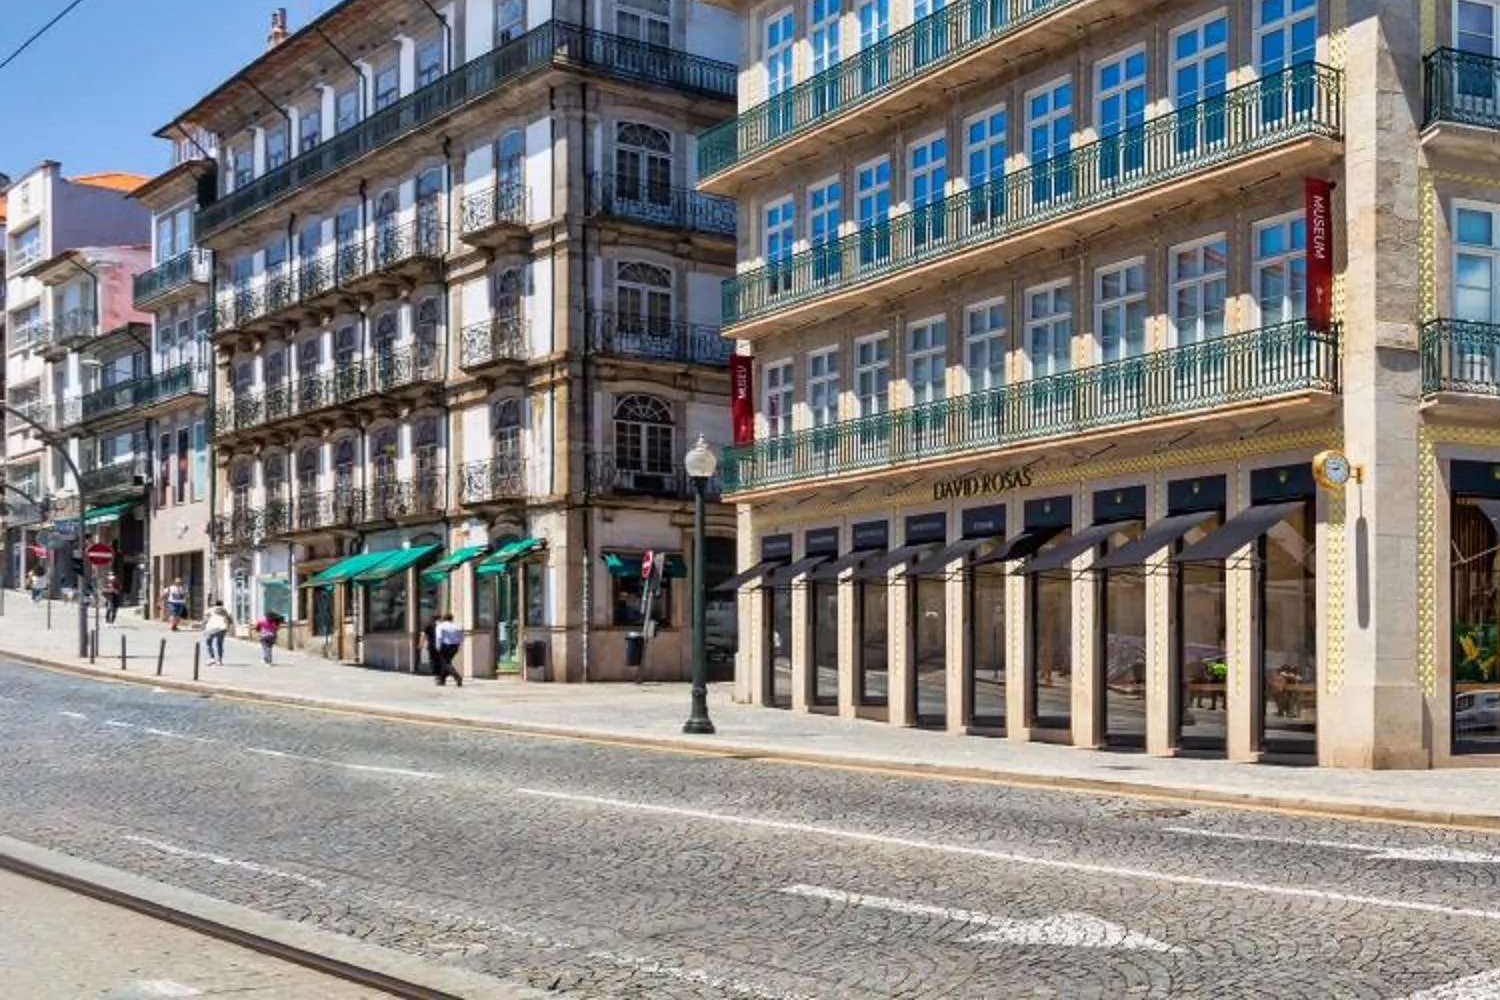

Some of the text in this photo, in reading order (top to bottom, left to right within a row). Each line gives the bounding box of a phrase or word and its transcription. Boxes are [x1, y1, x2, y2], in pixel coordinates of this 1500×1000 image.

[1312, 194, 1326, 259] MUSEUM
[933, 467, 1033, 500] DAVID ROSAS
